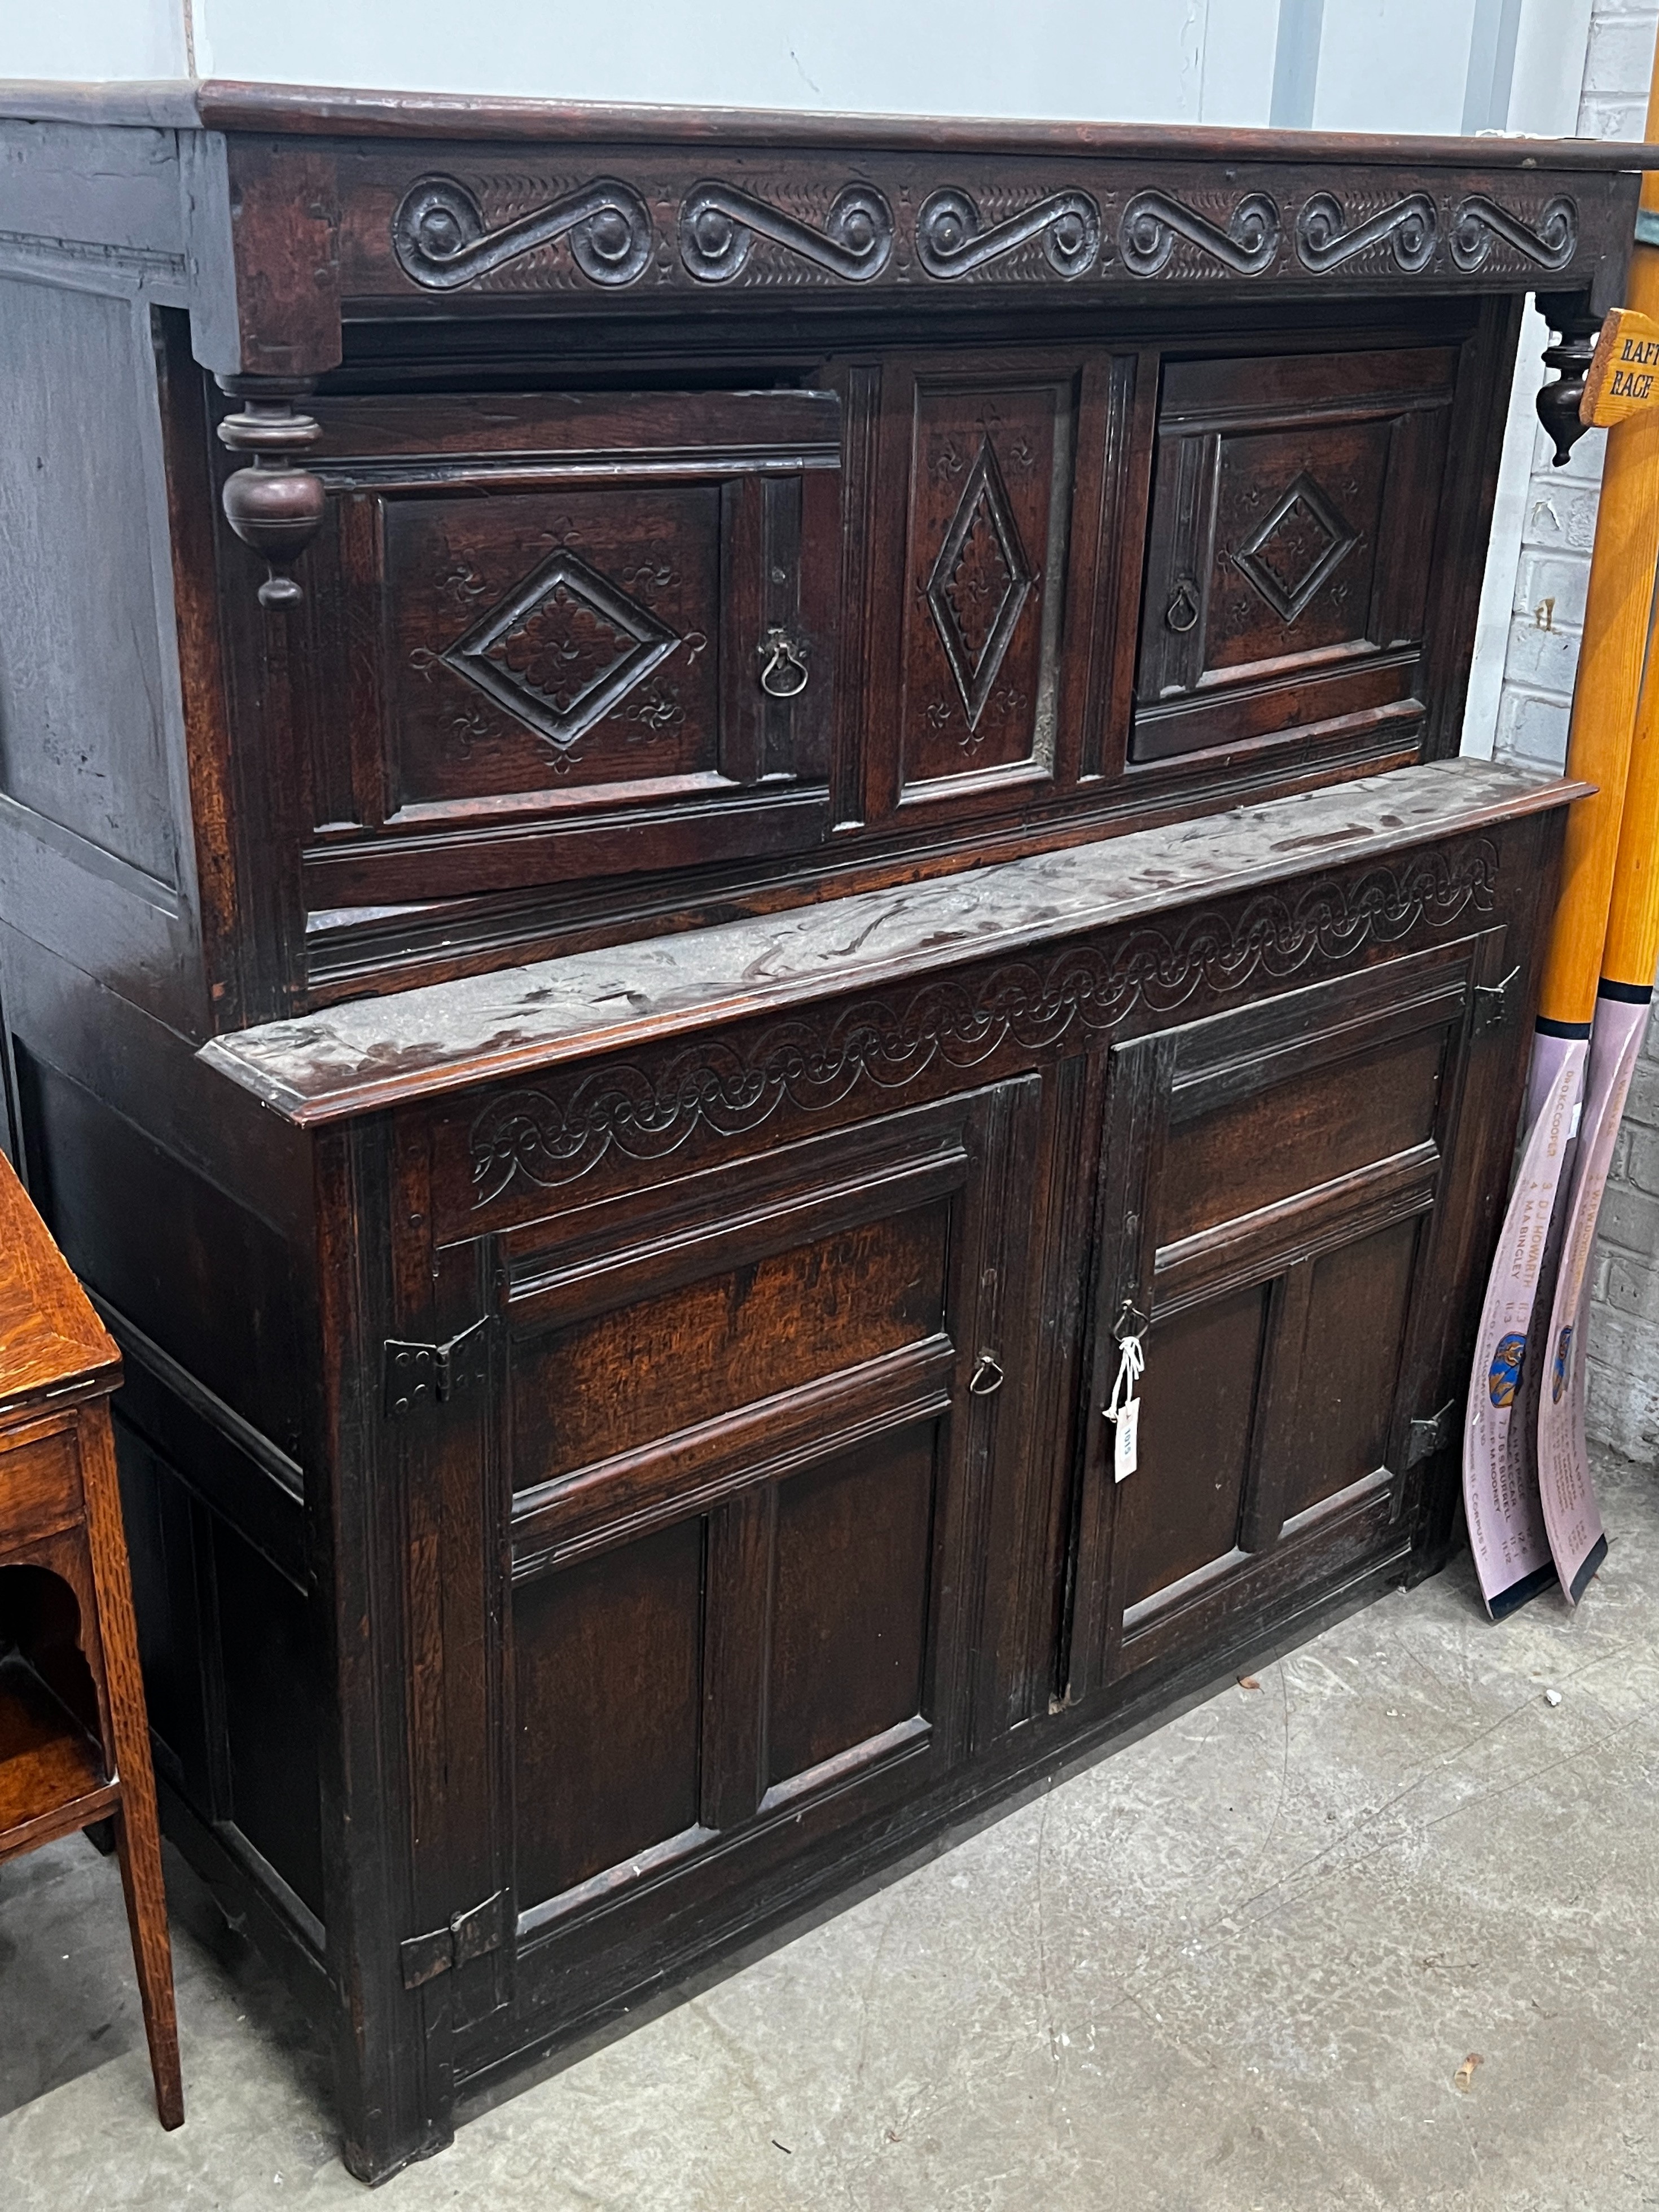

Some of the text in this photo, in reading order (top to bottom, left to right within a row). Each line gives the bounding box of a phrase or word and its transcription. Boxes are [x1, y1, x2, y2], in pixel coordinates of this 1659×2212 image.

[1621, 339, 1659, 366] RAFT
[1609, 370, 1654, 399] RACE
[1547, 1112, 1563, 1156] COOPER
[1511, 1226, 1528, 1279] BINGLEY
[1523, 1226, 1544, 1288] HOWARTH
[1490, 1462, 1502, 1512] RODNEY
[1499, 1465, 1512, 1523] BURRELL
[1472, 1493, 1485, 1544] CORPUS
